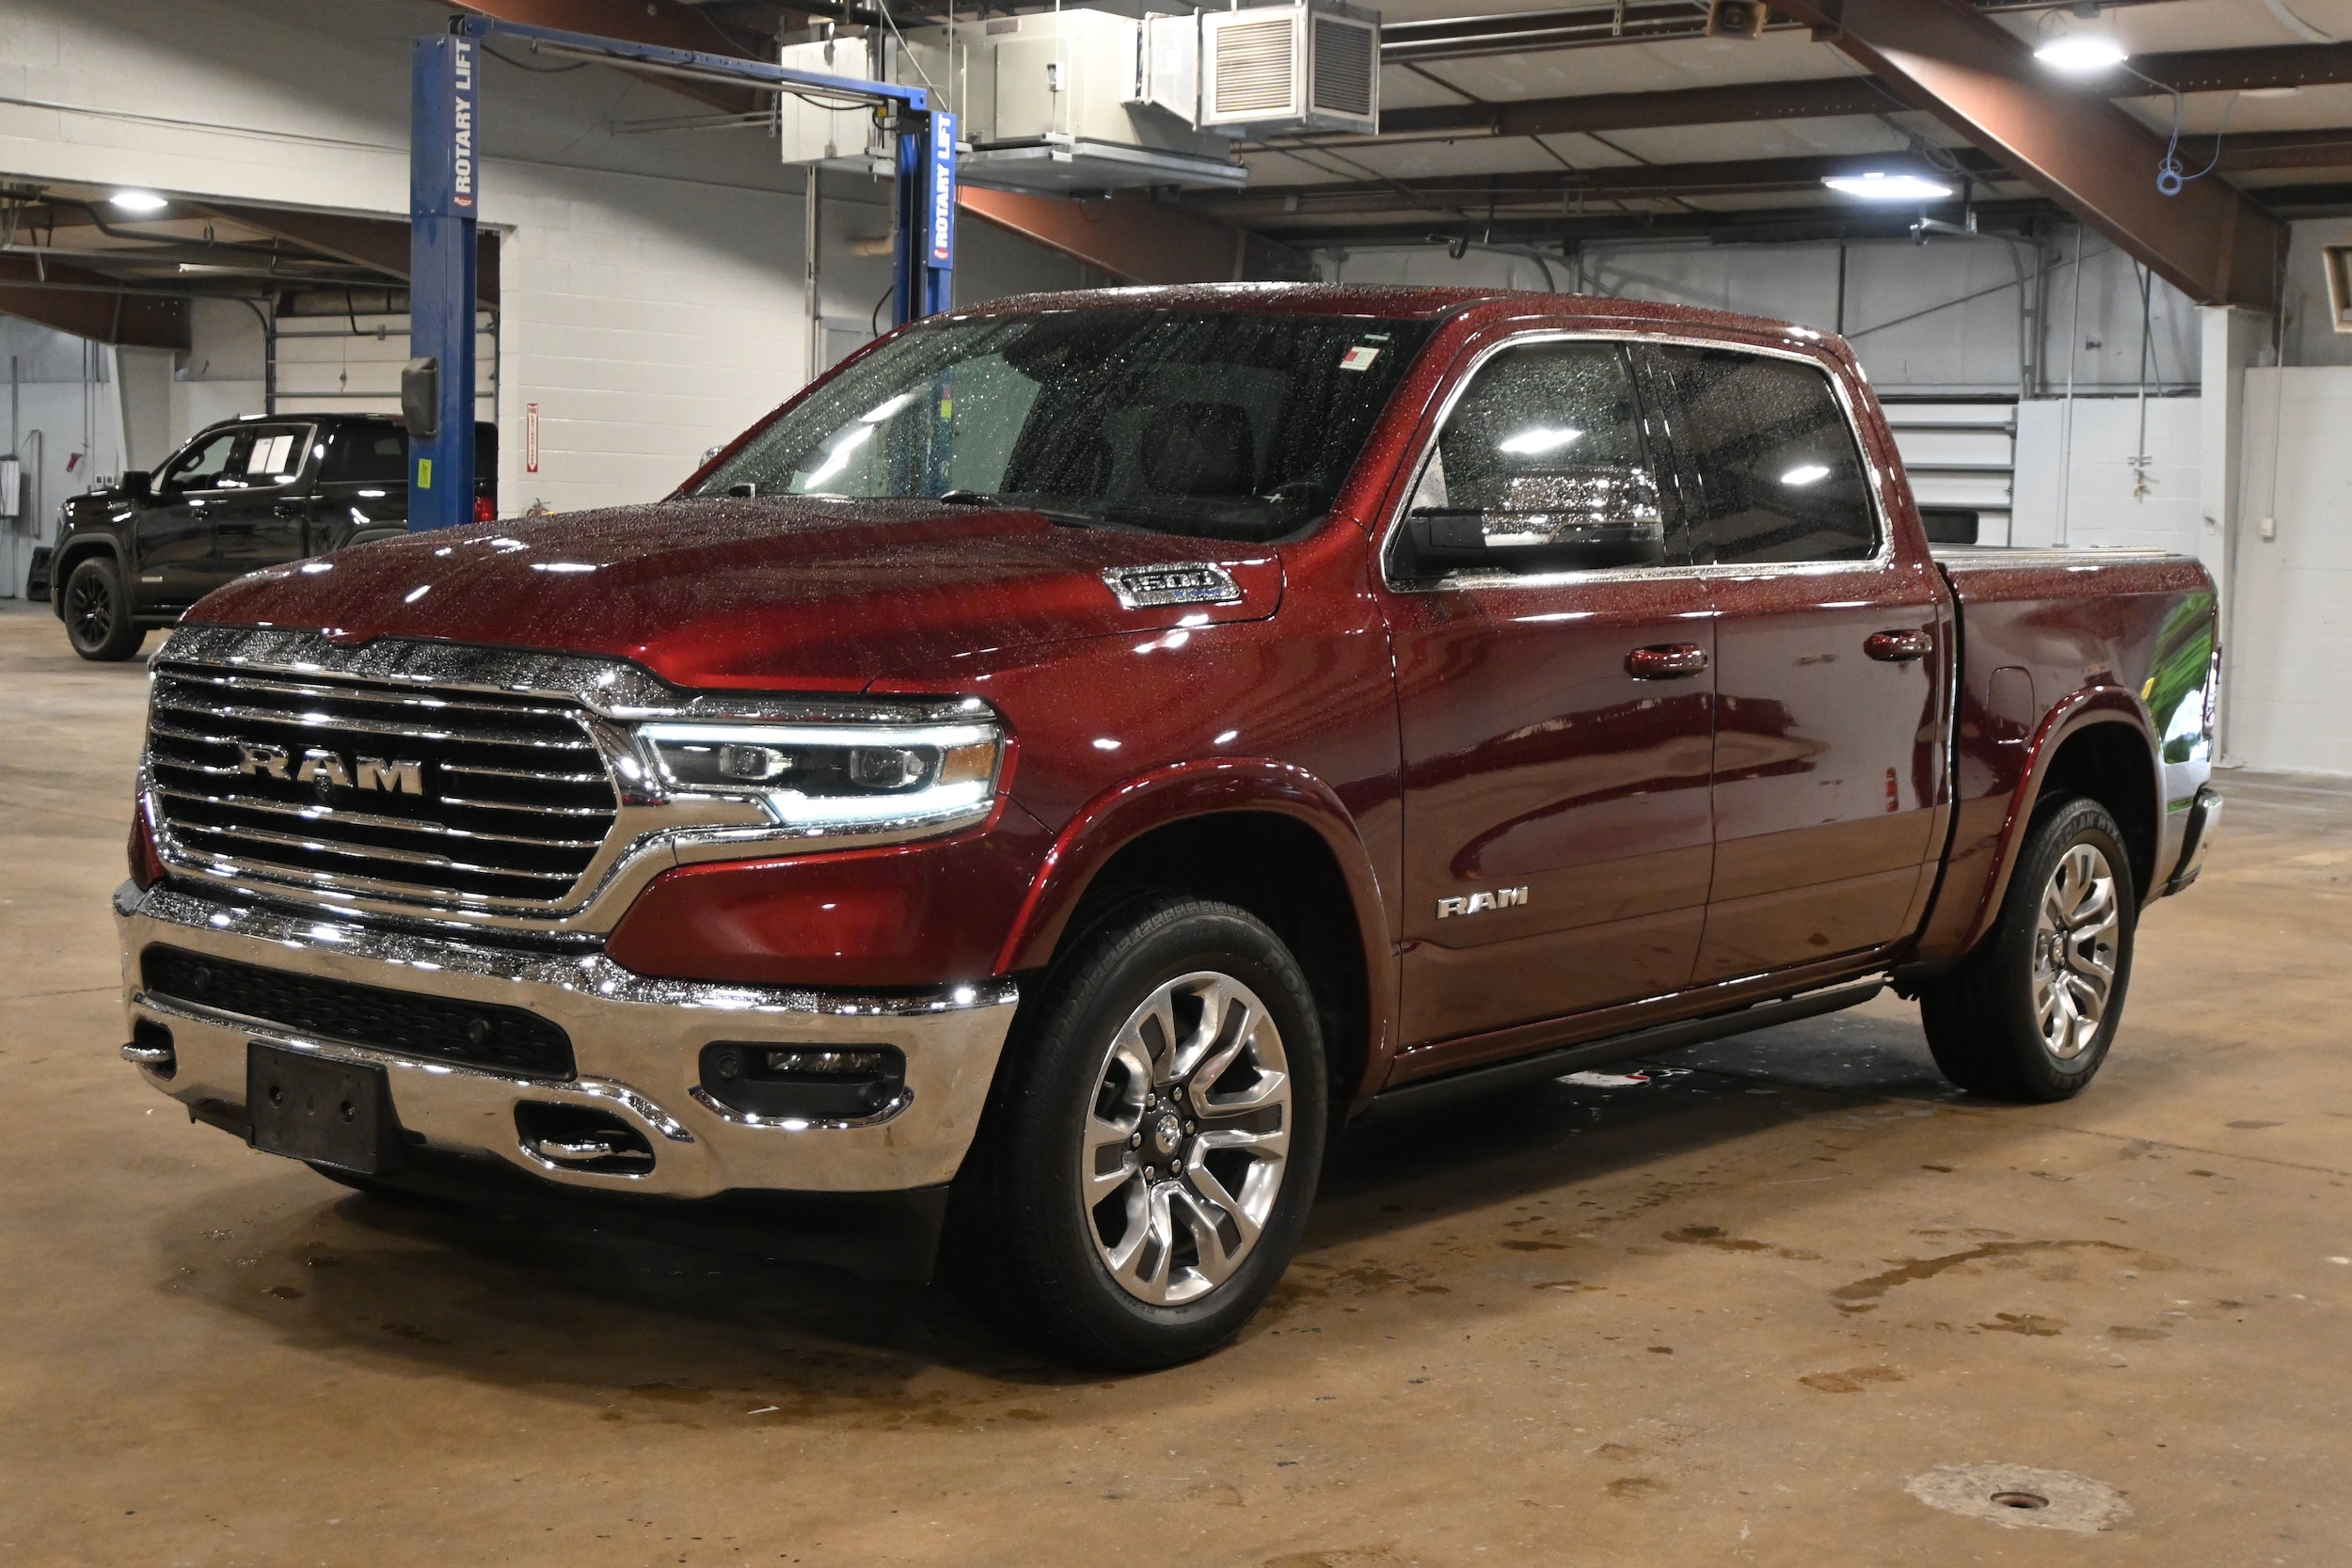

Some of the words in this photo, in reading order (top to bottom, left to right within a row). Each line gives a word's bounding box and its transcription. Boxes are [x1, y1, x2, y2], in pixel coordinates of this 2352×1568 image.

[455, 39, 470, 90] LIFT
[455, 96, 470, 194] ROTARY
[937, 114, 951, 160] LIFT
[935, 163, 949, 248] ROTARY
[239, 741, 423, 796] RAM
[1437, 885, 1529, 919] RAM
